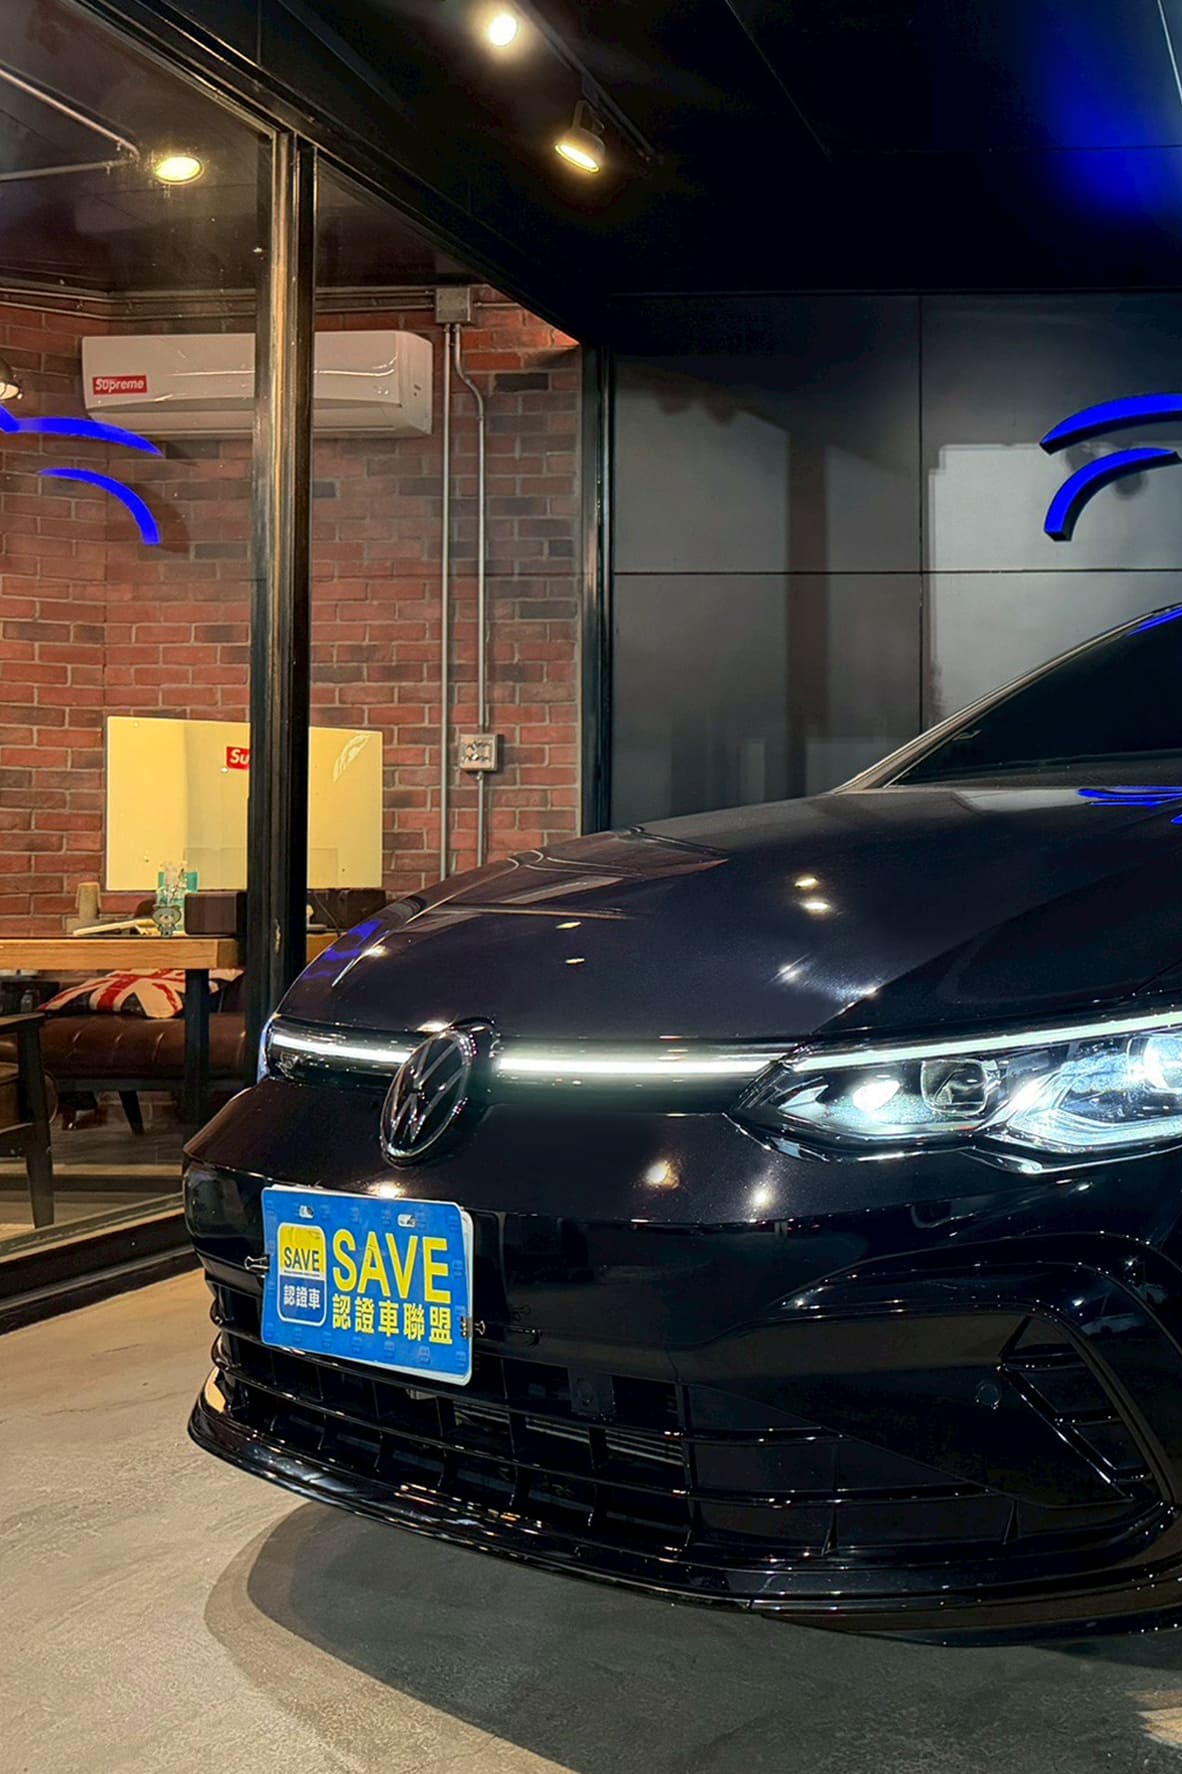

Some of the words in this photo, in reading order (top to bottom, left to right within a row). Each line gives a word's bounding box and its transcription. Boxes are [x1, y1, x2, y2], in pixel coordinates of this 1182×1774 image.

[284, 1247, 320, 1272] SAVE
[332, 1228, 451, 1304] SAVE
[283, 1283, 320, 1310] 認證車
[332, 1293, 453, 1344] 認證車聯盟
